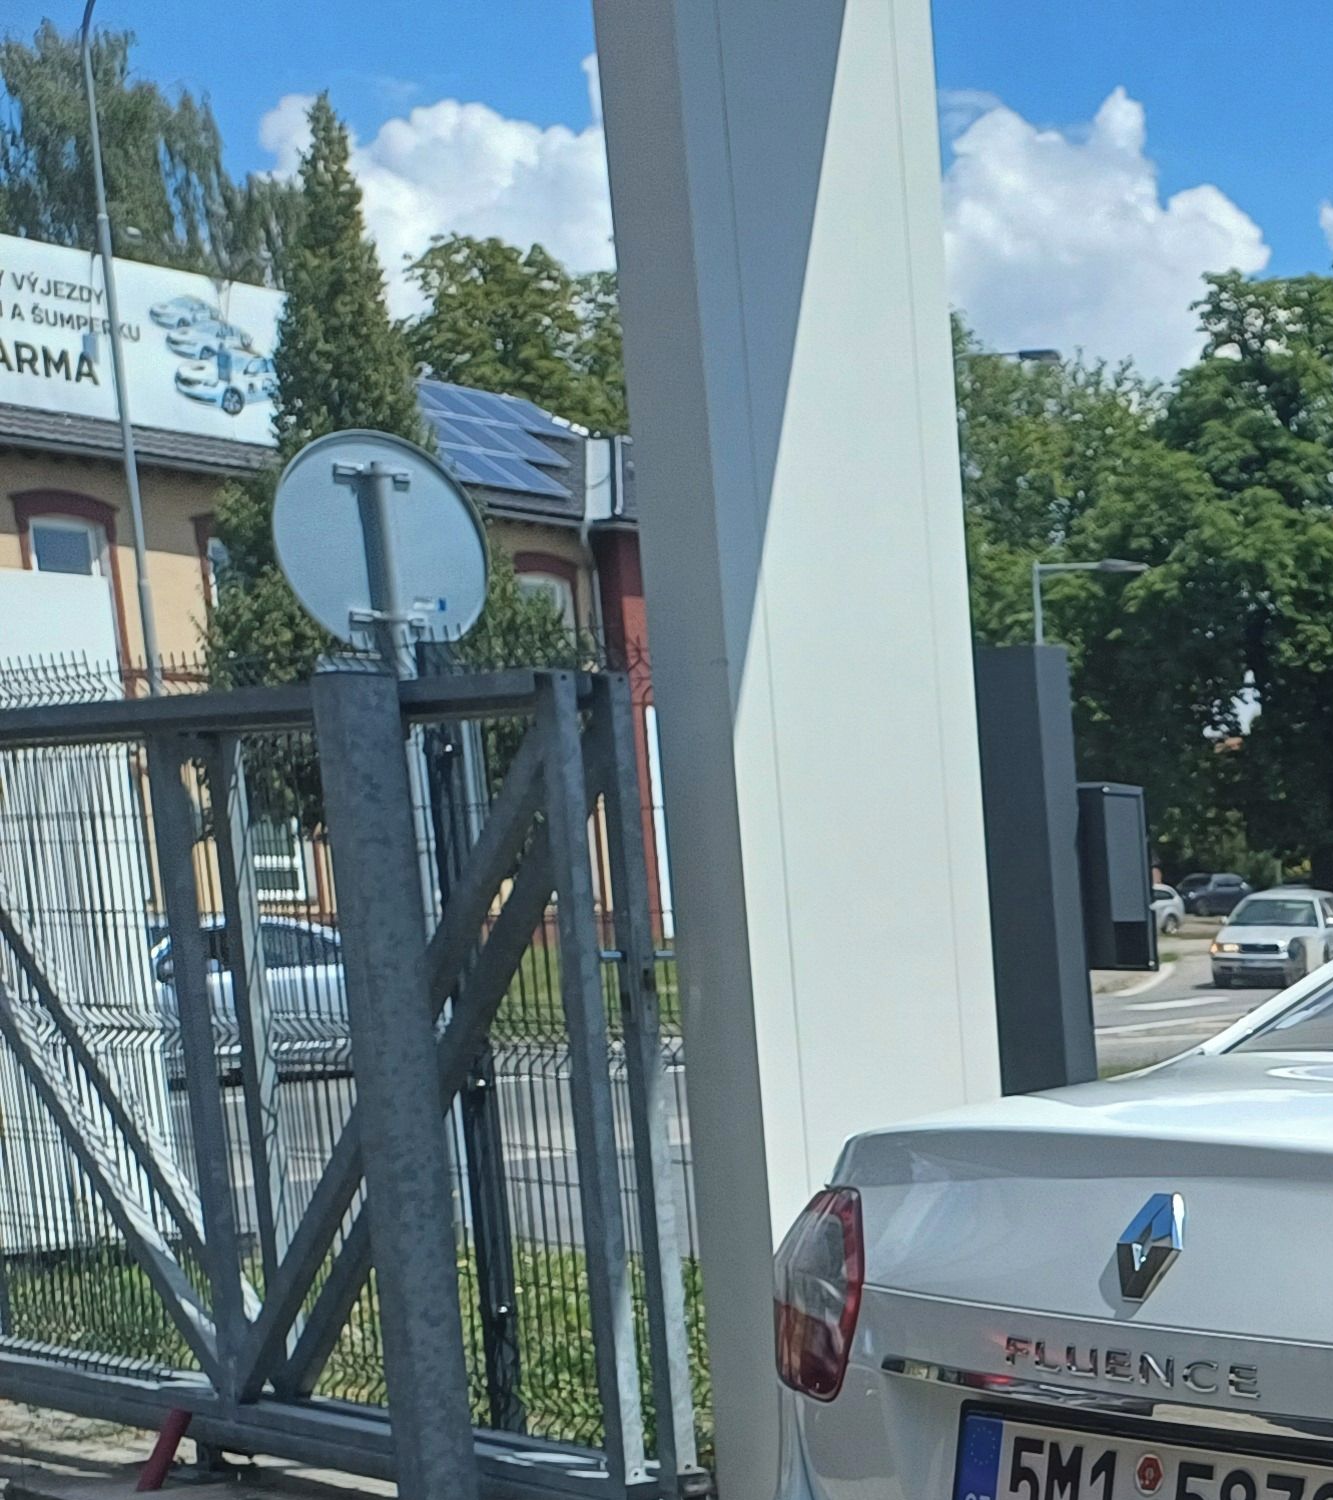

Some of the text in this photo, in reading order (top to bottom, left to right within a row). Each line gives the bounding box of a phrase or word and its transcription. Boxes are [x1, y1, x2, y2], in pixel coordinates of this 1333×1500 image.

[11, 271, 104, 304] VÝJEZDY
[11, 302, 25, 321] A
[1005, 1336, 1261, 1399] FLUENCE
